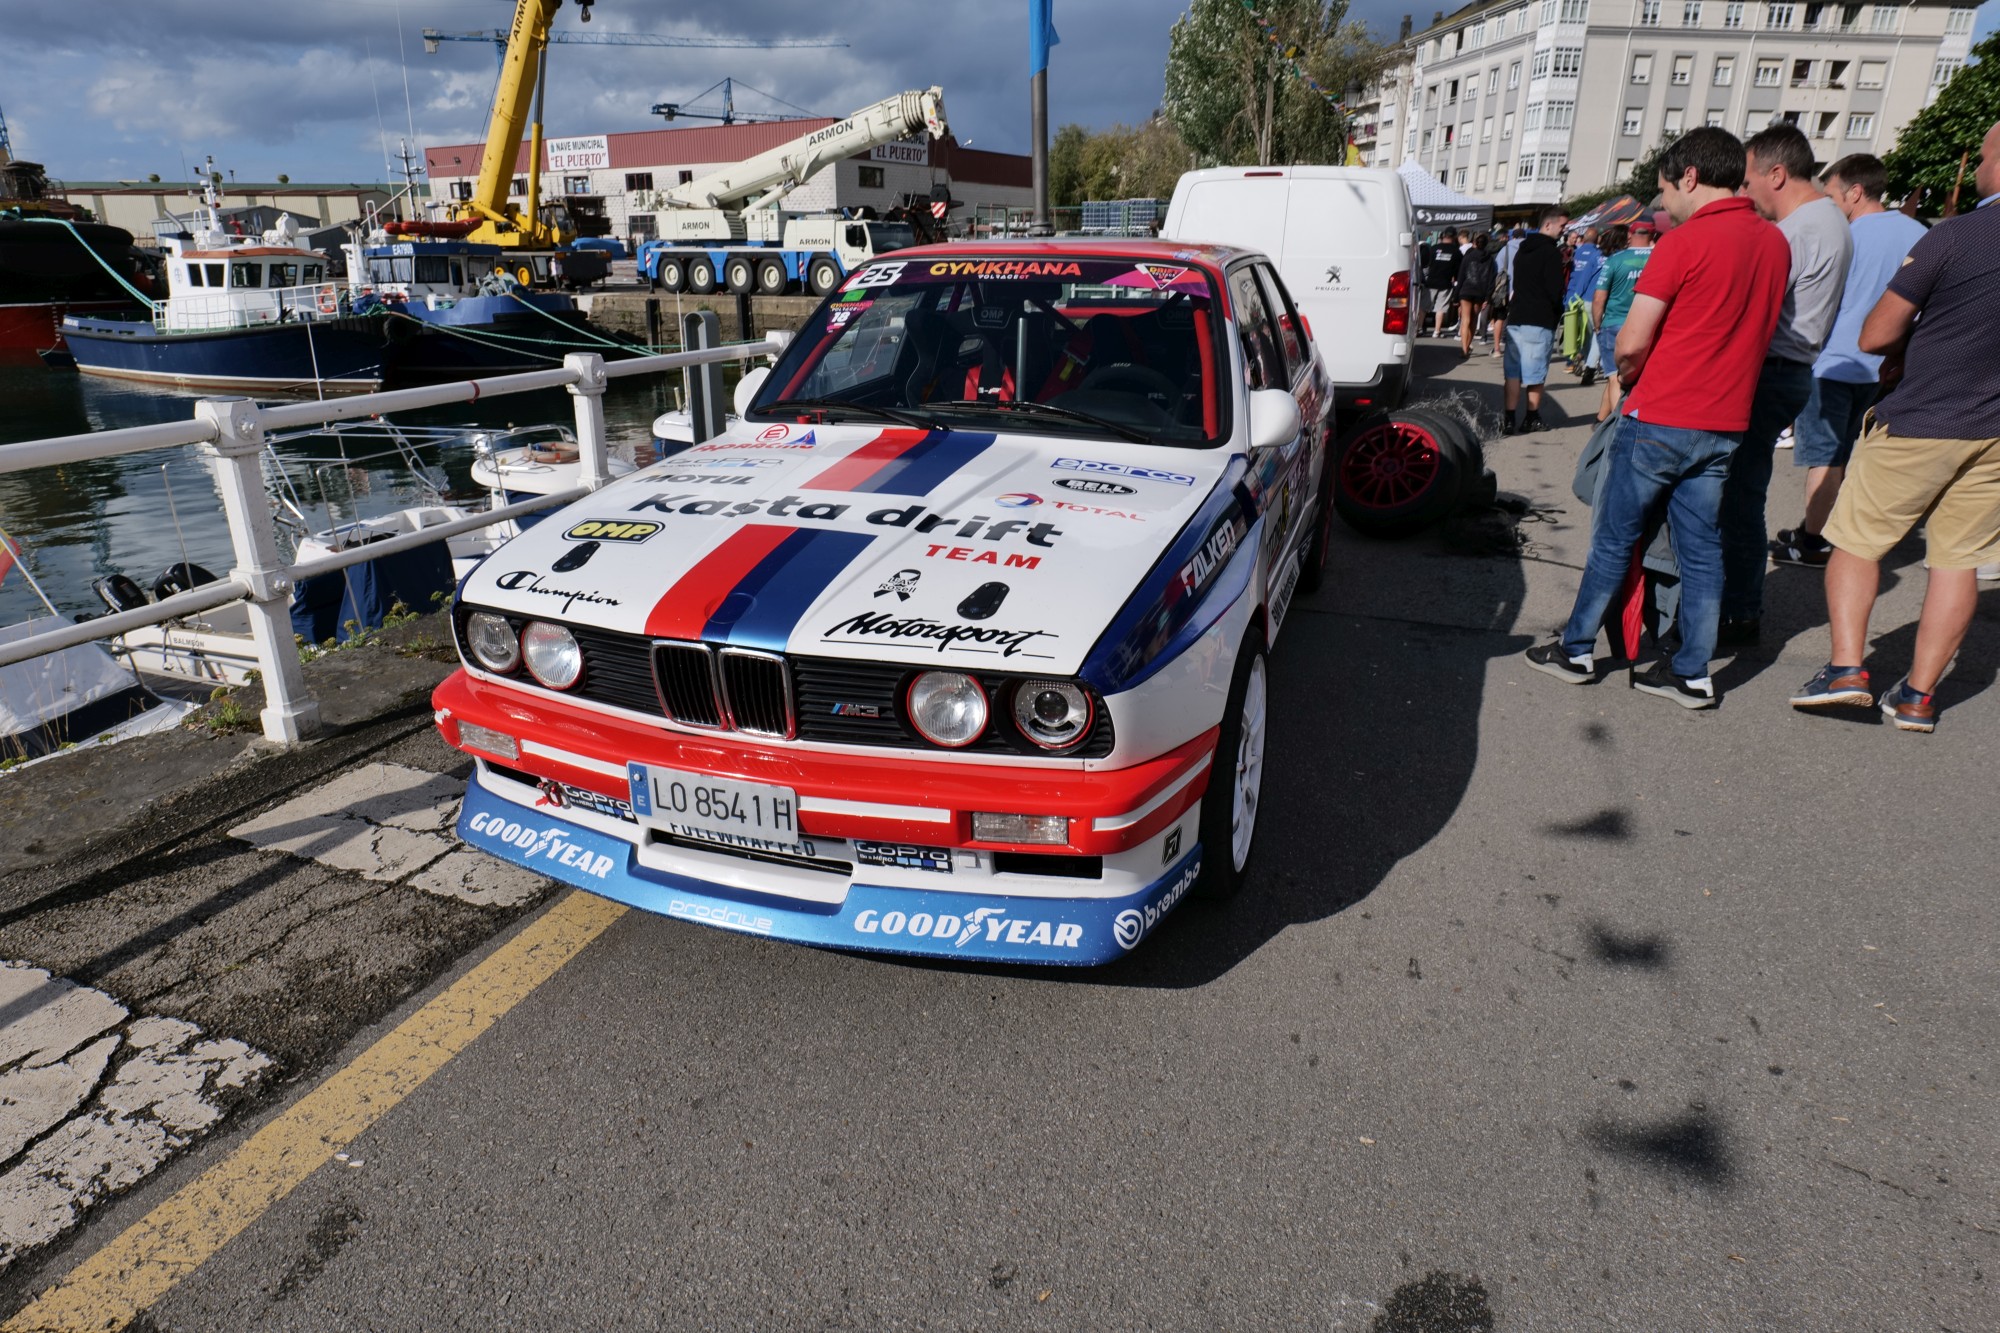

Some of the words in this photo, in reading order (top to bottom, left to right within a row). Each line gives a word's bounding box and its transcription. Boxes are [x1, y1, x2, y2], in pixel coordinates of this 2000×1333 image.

[809, 120, 854, 147] ARMON
[556, 141, 572, 152] NAVE
[572, 139, 605, 151] MUNICIPAL
[889, 145, 927, 162] PUERTO"
[1434, 211, 1478, 221] soarauto
[682, 221, 710, 231] ARMON
[799, 238, 831, 246] ARMON
[858, 266, 898, 285] 25
[929, 262, 1082, 276] GYMKHANA
[1149, 266, 1179, 275] DRIFT
[831, 311, 851, 323] 18
[634, 474, 755, 485] MOTUL
[1055, 457, 1194, 485] sparco
[1066, 479, 1126, 494] BELL
[628, 493, 852, 521] Kasta
[866, 502, 1064, 548] drift
[1052, 501, 1146, 522] TOTAL
[571, 522, 657, 539] OMP
[925, 544, 1042, 571] TEAM
[1181, 518, 1237, 598] FALKEN
[496, 571, 623, 614] Champion
[823, 611, 1059, 658] Motorsport
[838, 702, 880, 718] M3
[563, 784, 631, 811] GoPro
[636, 794, 647, 807] E
[694, 786, 762, 827] 8541
[773, 797, 792, 831] H
[856, 841, 948, 861] GoPro
[1144, 861, 1201, 930] brembo
[668, 899, 774, 930] prodrive
